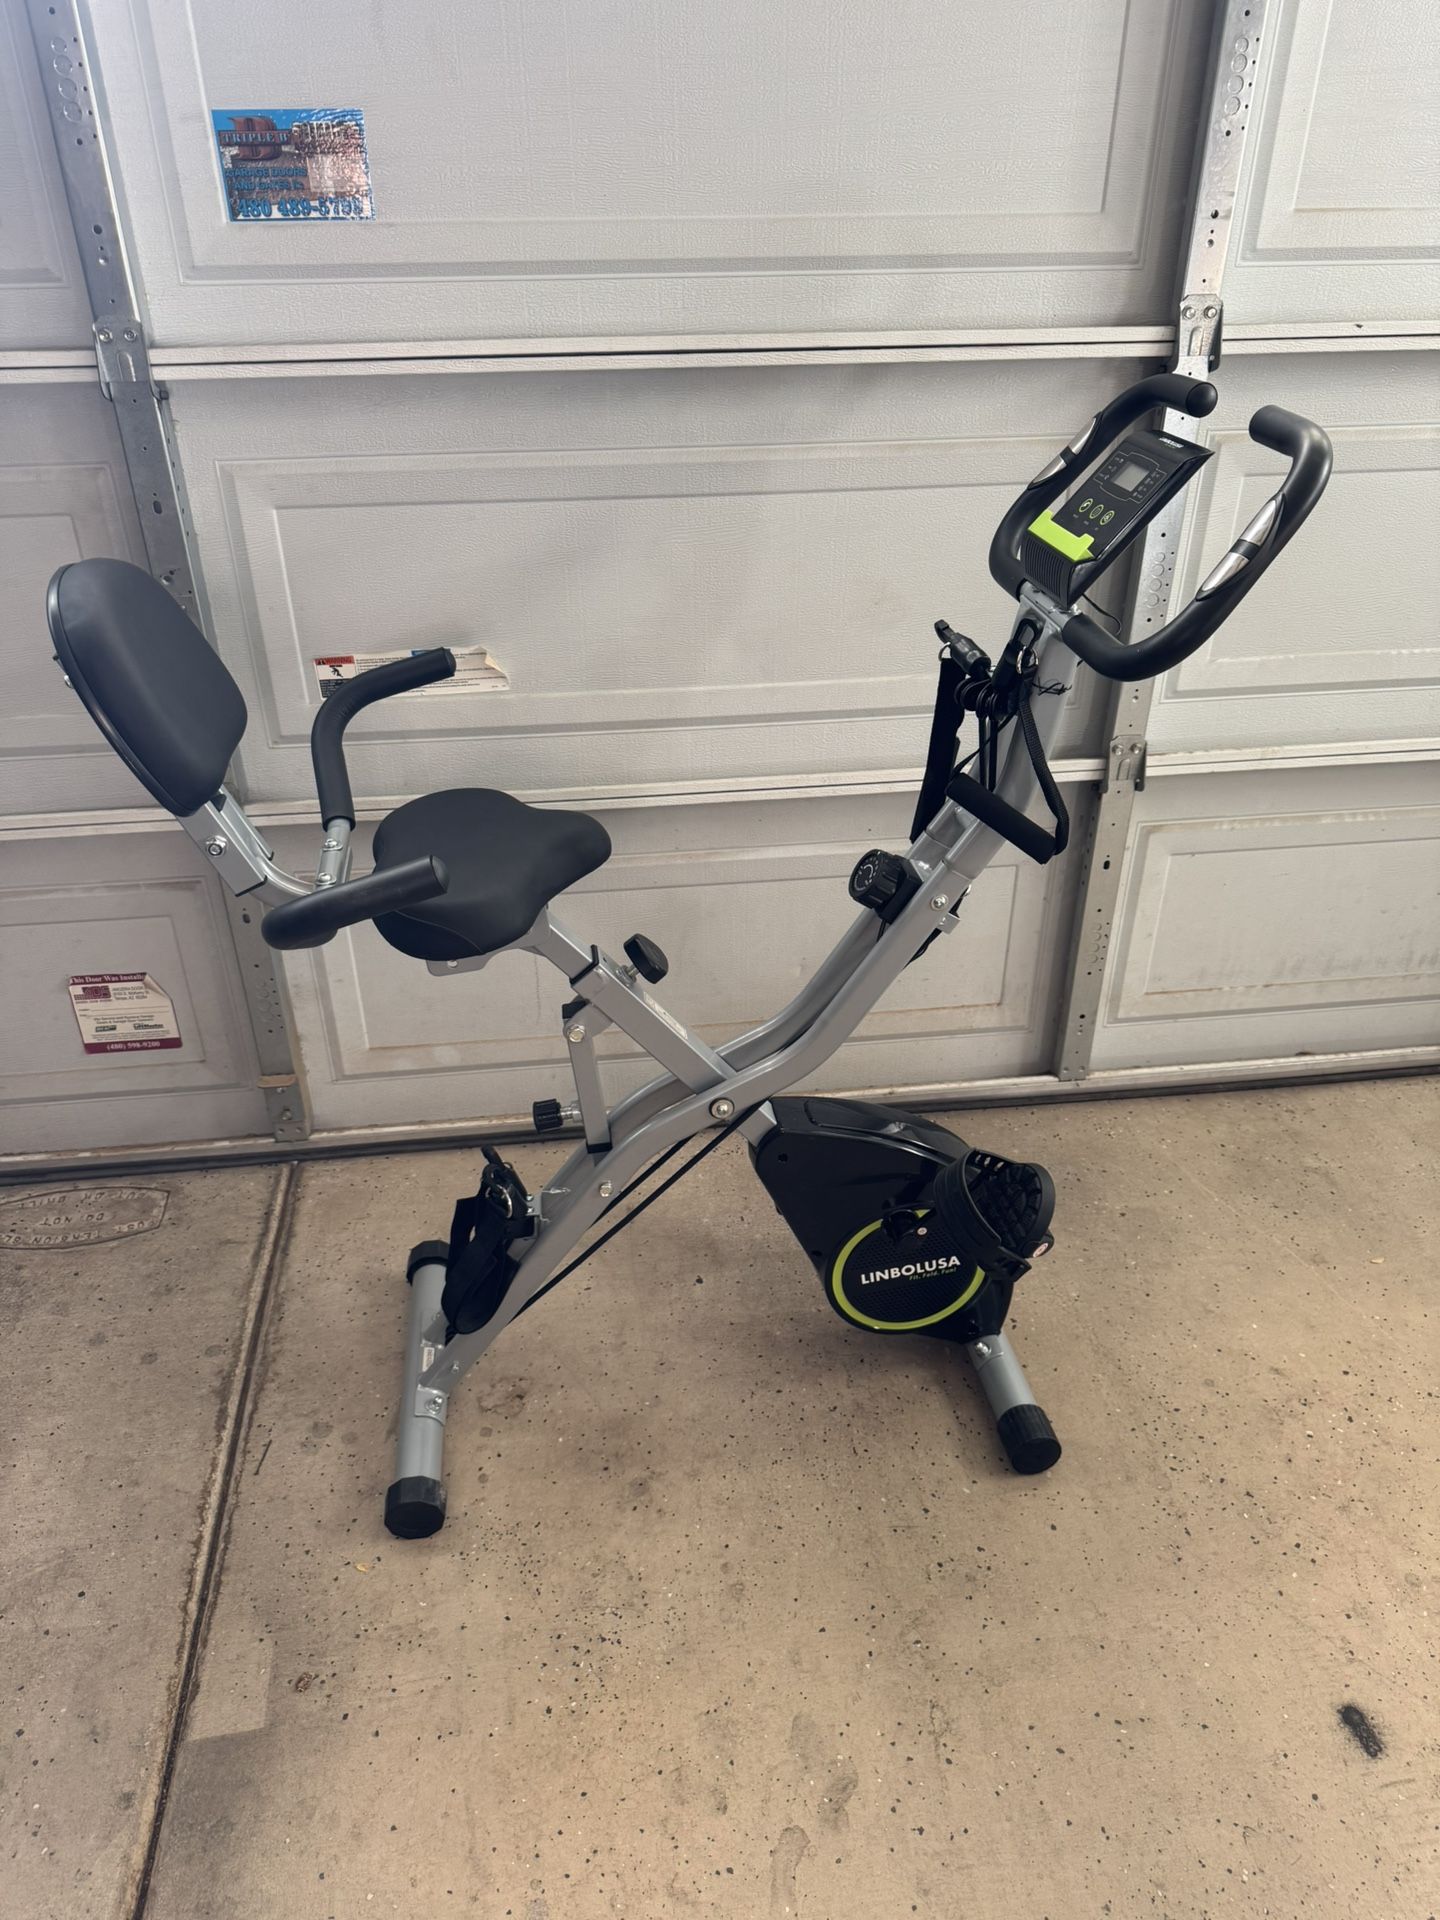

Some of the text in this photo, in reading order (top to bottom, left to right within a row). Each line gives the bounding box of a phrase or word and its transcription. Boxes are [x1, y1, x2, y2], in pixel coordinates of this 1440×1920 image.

[223, 133, 274, 143] TRIPLE
[237, 198, 272, 217] 480
[39, 1212, 105, 1227] DO NOT
[861, 1256, 961, 1285] LINBOLUSA
